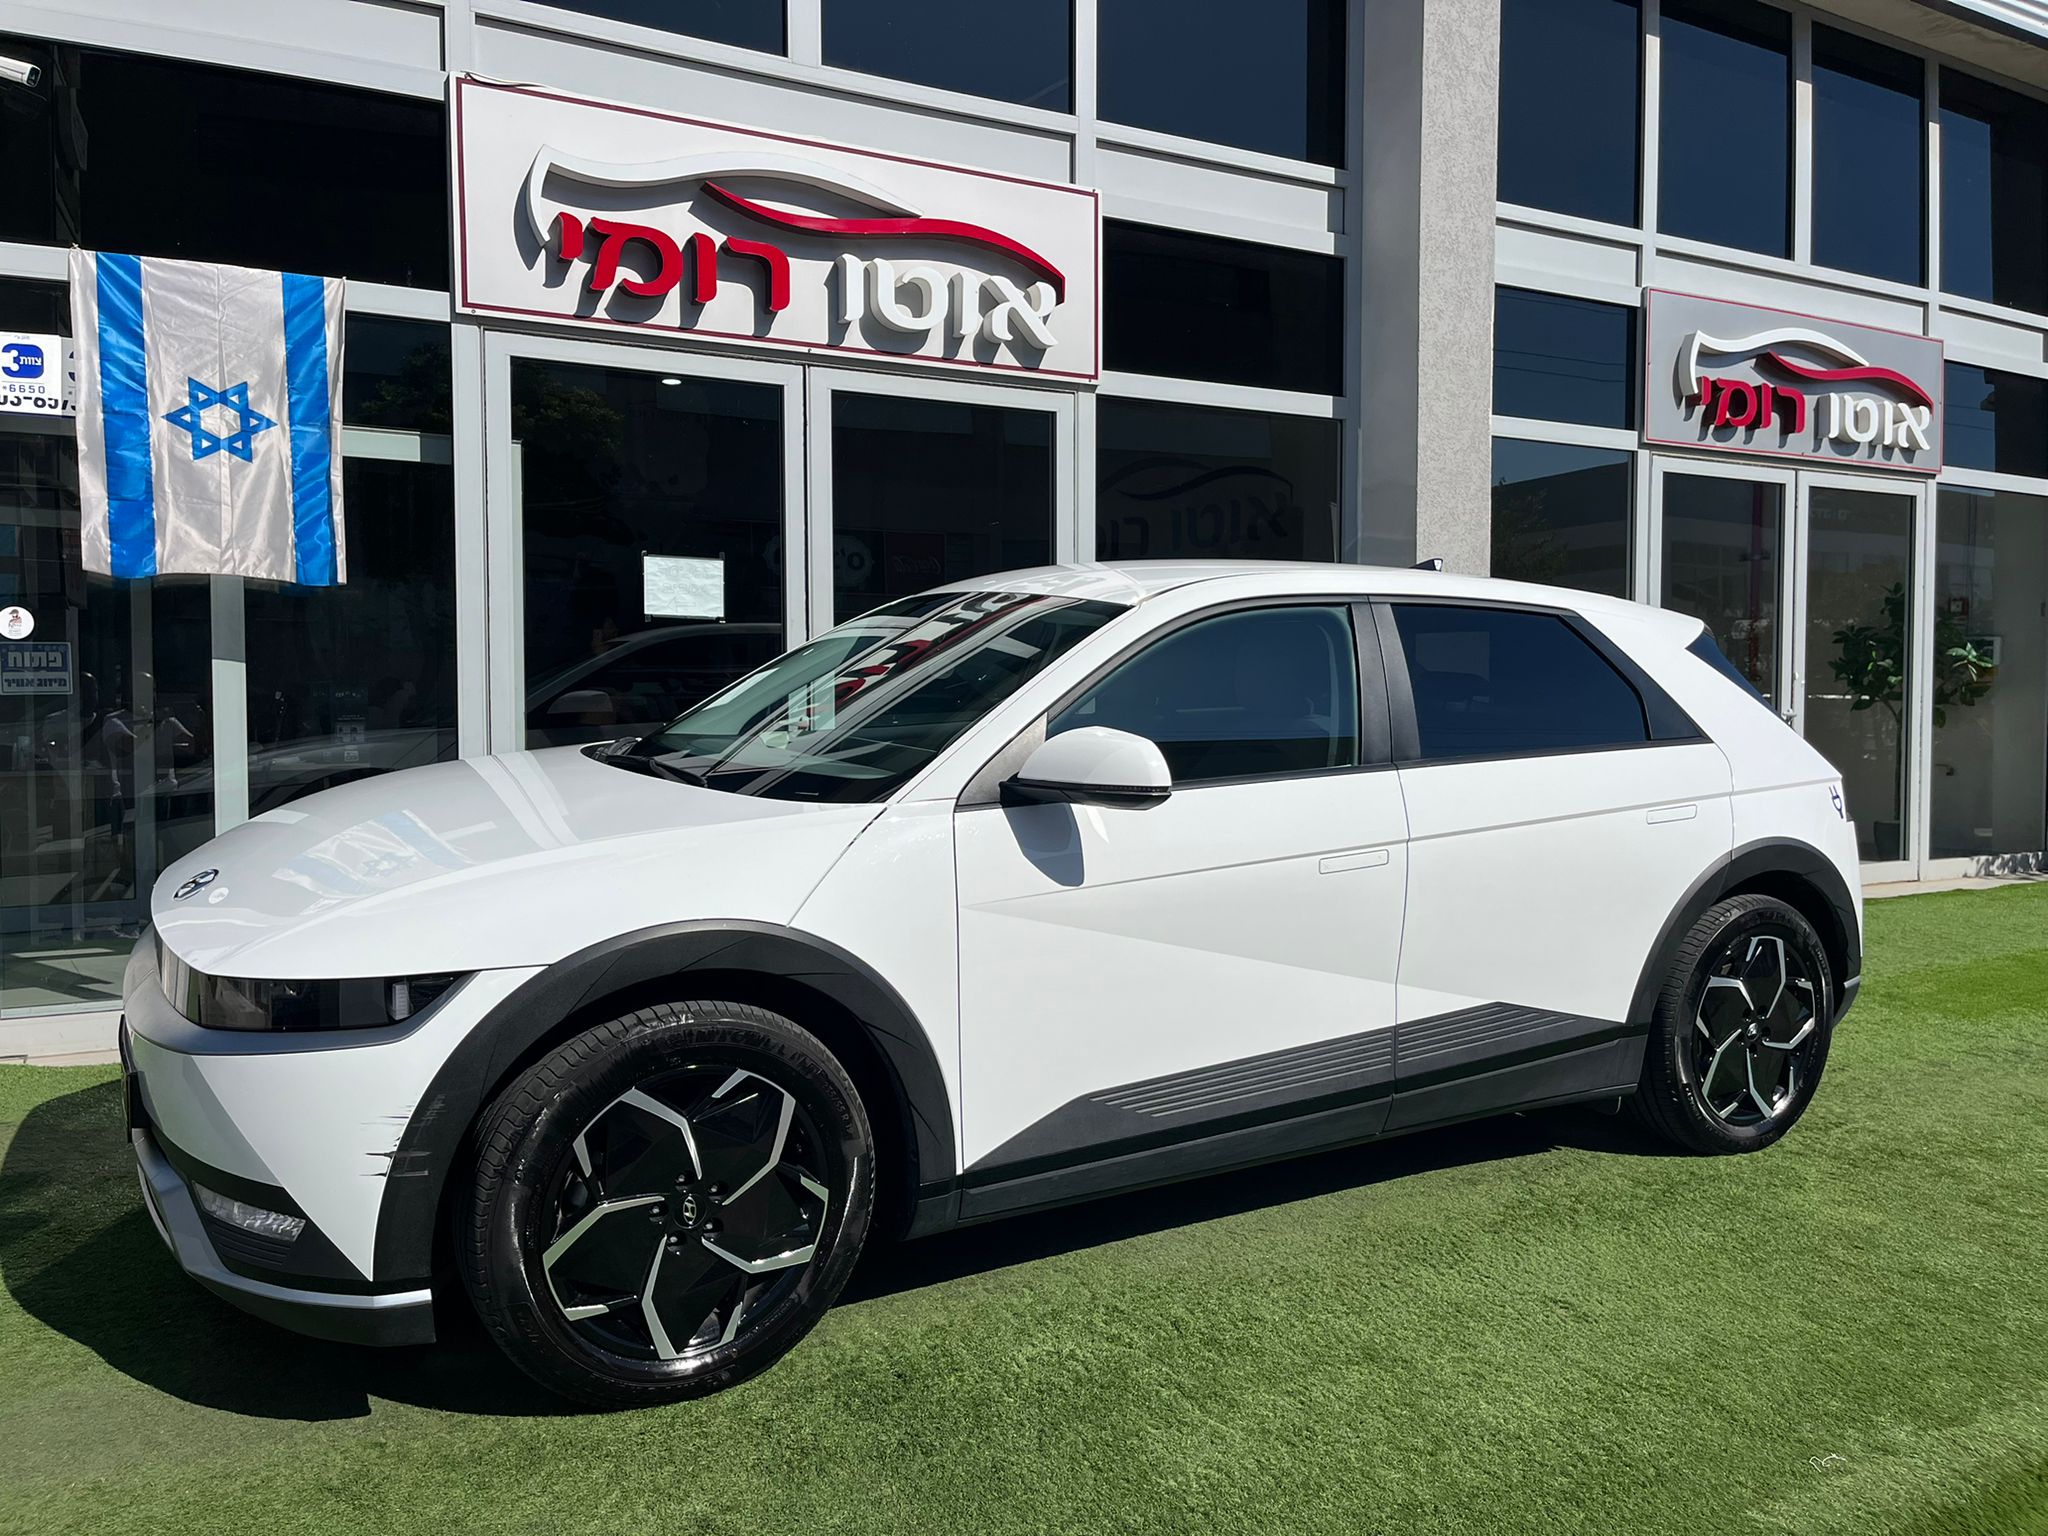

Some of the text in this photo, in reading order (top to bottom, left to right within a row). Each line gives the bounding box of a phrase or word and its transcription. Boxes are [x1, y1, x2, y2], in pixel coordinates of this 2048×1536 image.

[555, 211, 1060, 349] אוטו רומי
[20, 355, 42, 366] צוות
[1699, 375, 1932, 451] אוטו רומי
[8, 651, 62, 667] פתוח
